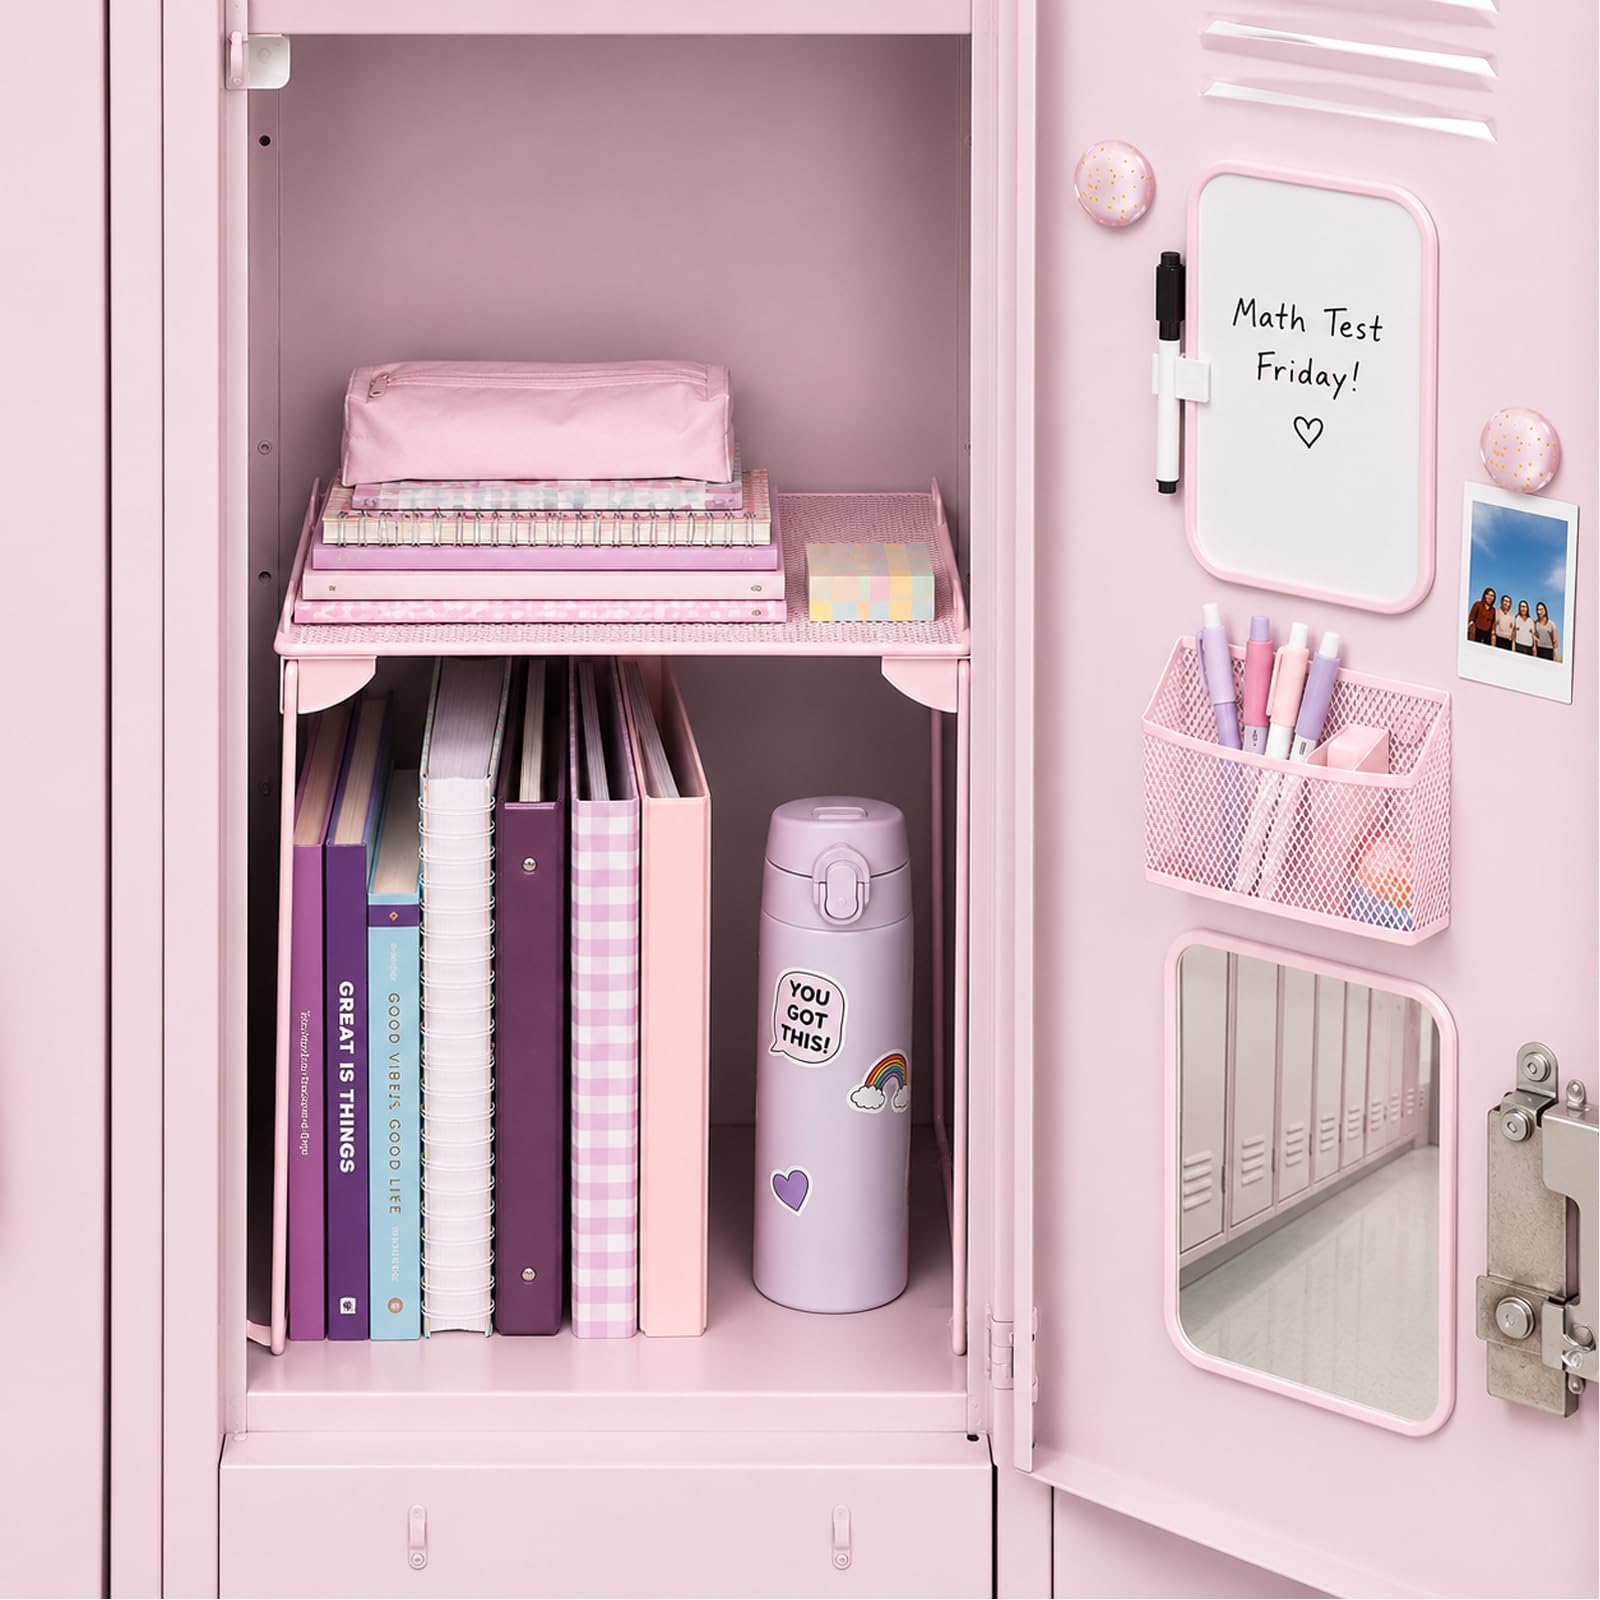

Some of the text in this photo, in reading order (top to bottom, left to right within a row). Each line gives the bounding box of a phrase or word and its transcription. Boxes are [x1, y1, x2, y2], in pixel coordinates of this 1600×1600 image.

[1232, 297, 1383, 342] Math Test
[1257, 351, 1360, 400] Friday!
[787, 1003, 829, 1029] GOT
[790, 980, 830, 1006] YOU
[387, 992, 401, 1044] GOOD
[781, 1024, 830, 1054] THIS!
[338, 980, 356, 1174] GREAT IS THINGS
[388, 1118, 401, 1171] GOOD
